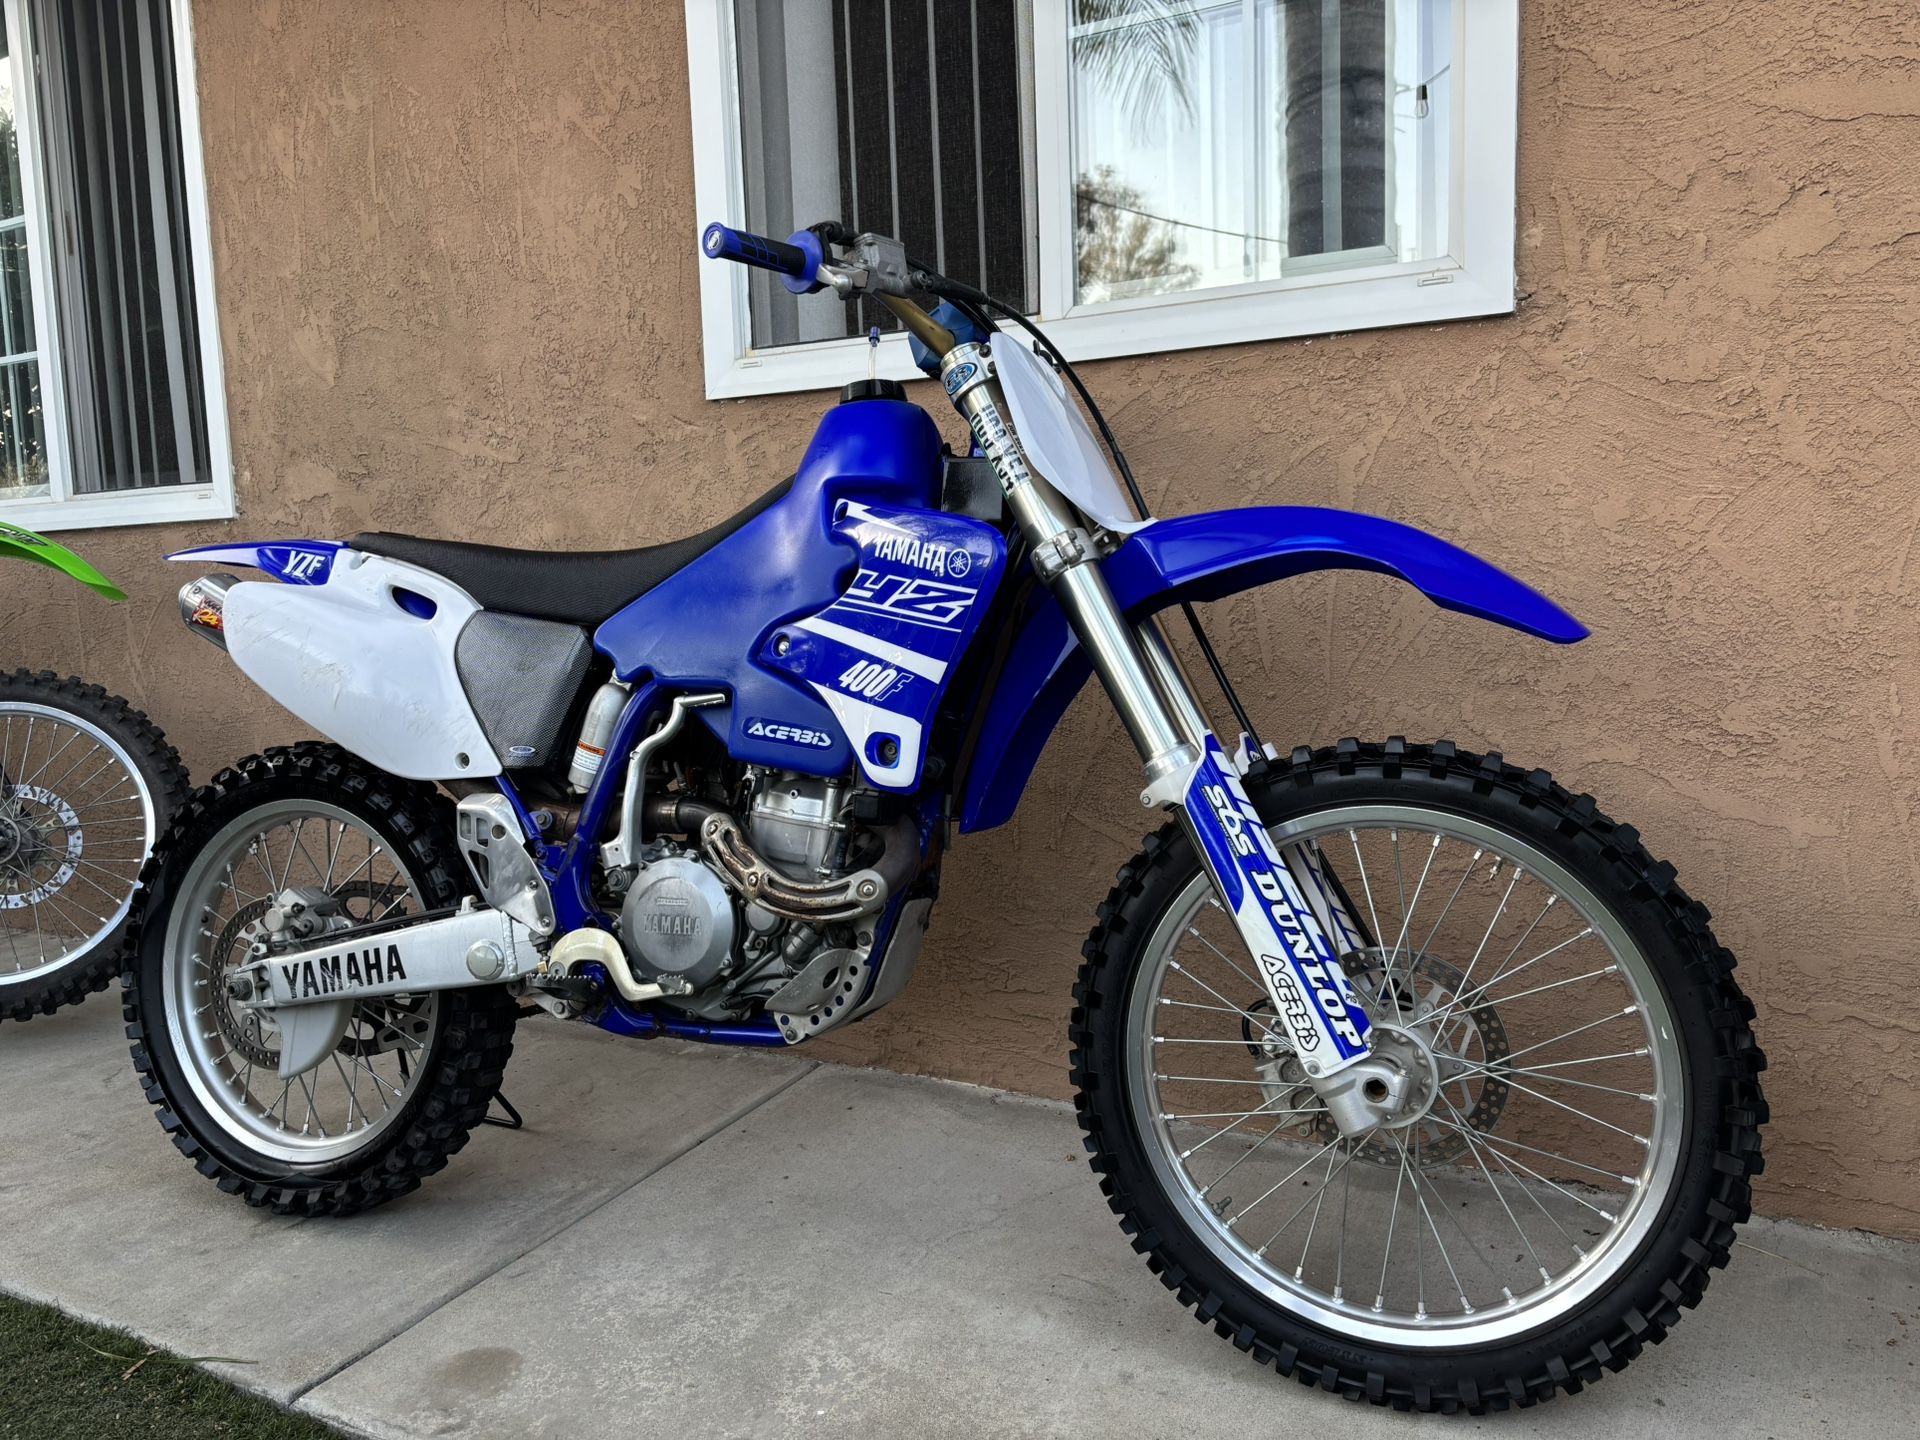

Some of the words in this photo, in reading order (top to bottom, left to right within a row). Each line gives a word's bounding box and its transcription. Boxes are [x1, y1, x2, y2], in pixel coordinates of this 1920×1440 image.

[282, 550, 325, 579] YZF
[873, 532, 946, 573] YAMAHA
[838, 660, 914, 701] 400F
[643, 913, 702, 936] YAMAHA
[281, 944, 407, 1000] YAMAHA
[1251, 868, 1364, 1049] DUNLOP
